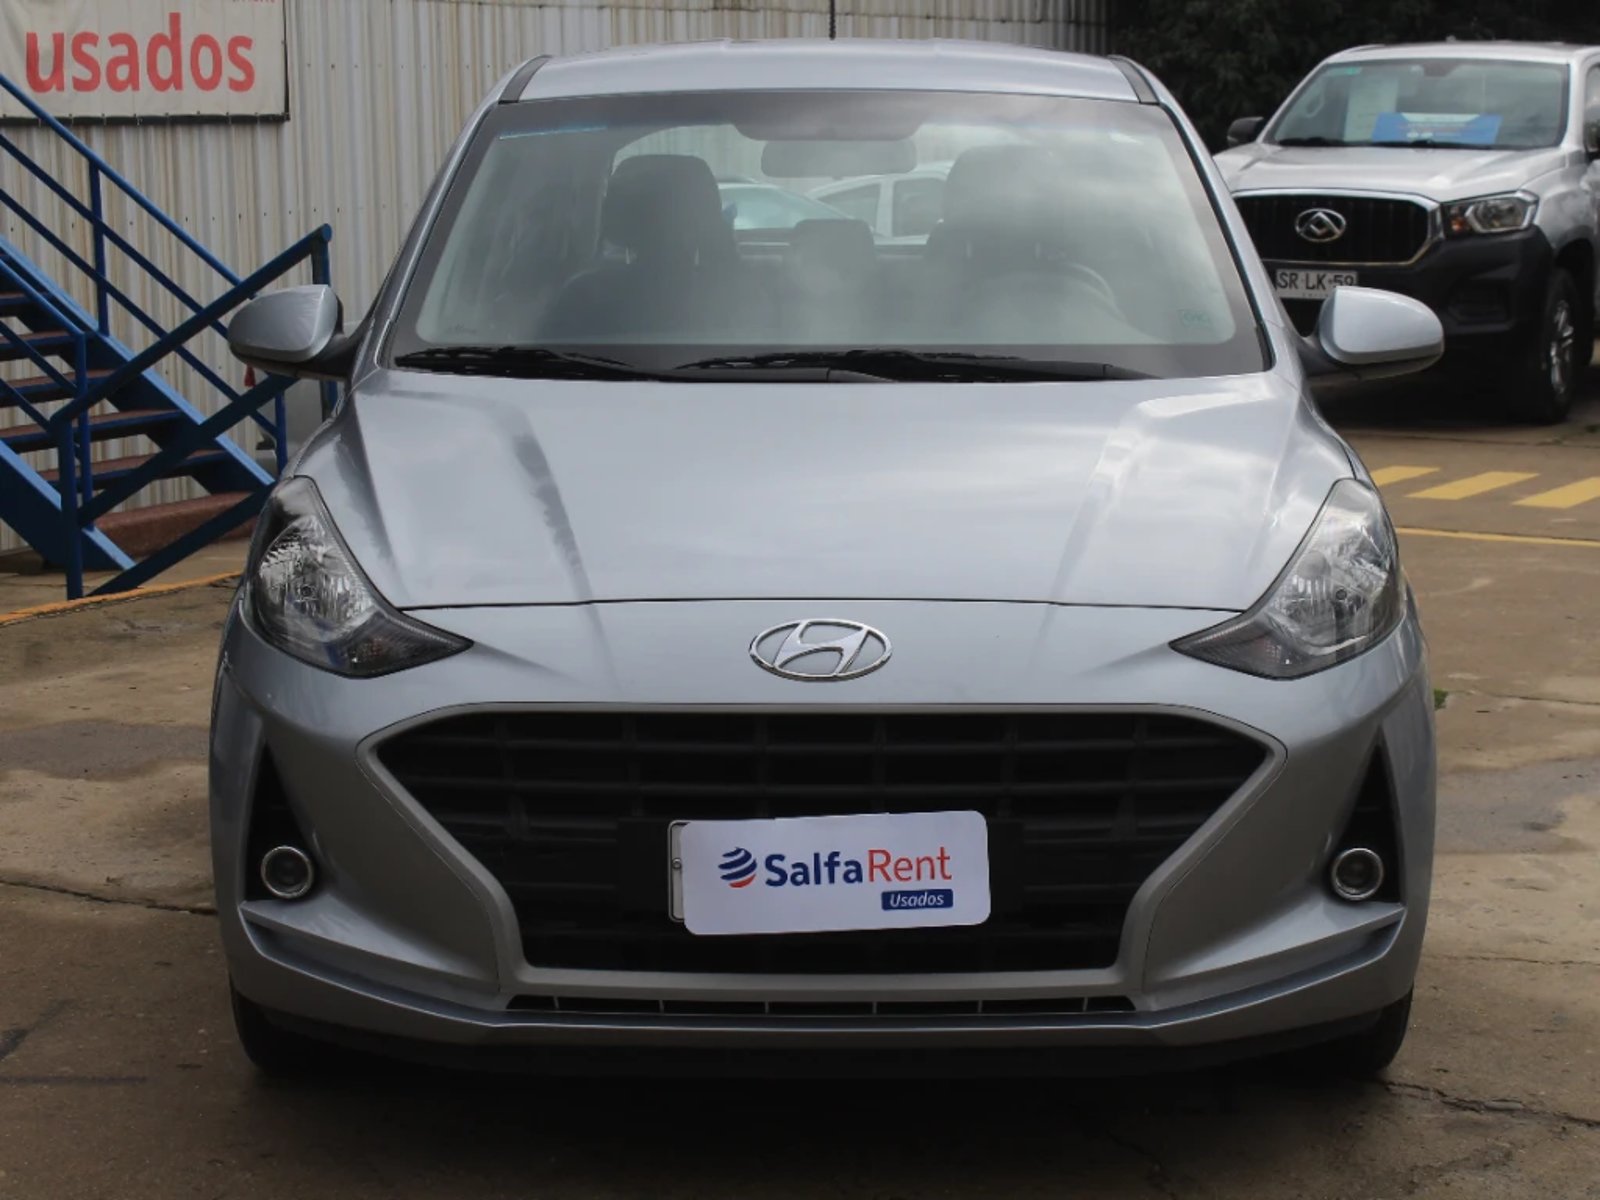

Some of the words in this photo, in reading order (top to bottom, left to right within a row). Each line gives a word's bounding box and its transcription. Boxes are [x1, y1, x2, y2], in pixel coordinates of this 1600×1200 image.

[26, 12, 256, 93] usados
[764, 846, 953, 887] SalfaRent
[889, 891, 945, 908] Usados
